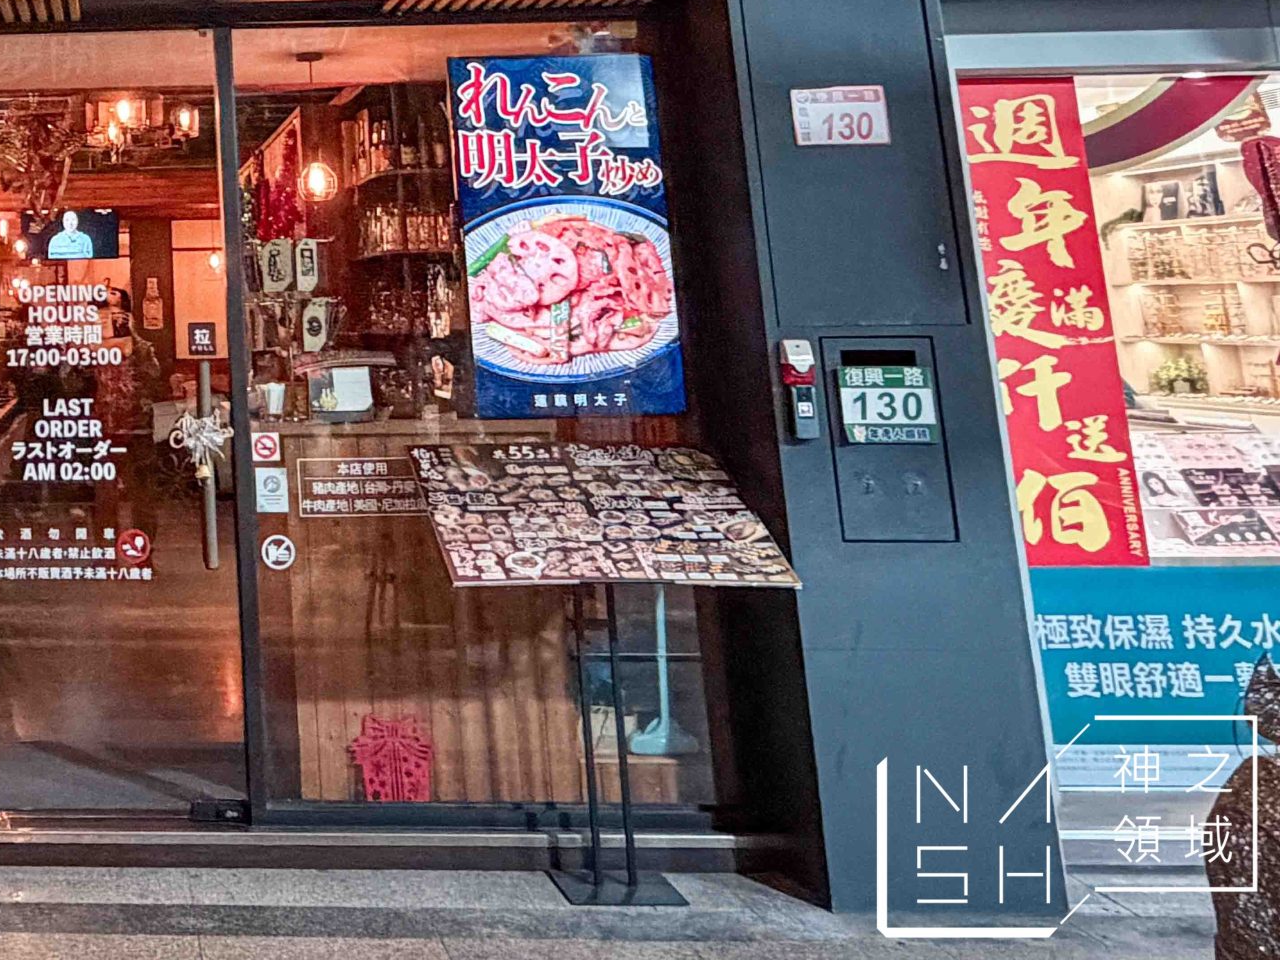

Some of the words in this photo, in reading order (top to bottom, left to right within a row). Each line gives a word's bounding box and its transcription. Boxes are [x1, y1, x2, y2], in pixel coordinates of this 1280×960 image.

[822, 111, 873, 141] 130
[18, 283, 108, 303] OPENING
[28, 305, 99, 324] HOURS
[193, 329, 211, 345] 拉
[6, 347, 122, 367] 17:00-03:00
[844, 367, 924, 387] 復興一路
[43, 398, 94, 417] LAST
[853, 391, 923, 421] 130
[34, 420, 103, 438] ORDER
[11, 440, 128, 460] ラストオーダー
[23, 462, 56, 481] AM
[60, 462, 116, 481] 02:00
[337, 462, 388, 476] 本店使用
[1117, 467, 1144, 558] ANNIVERSARY
[1034, 613, 1174, 651] 極致保濕
[1065, 661, 1265, 698] 雙眼舒適一
